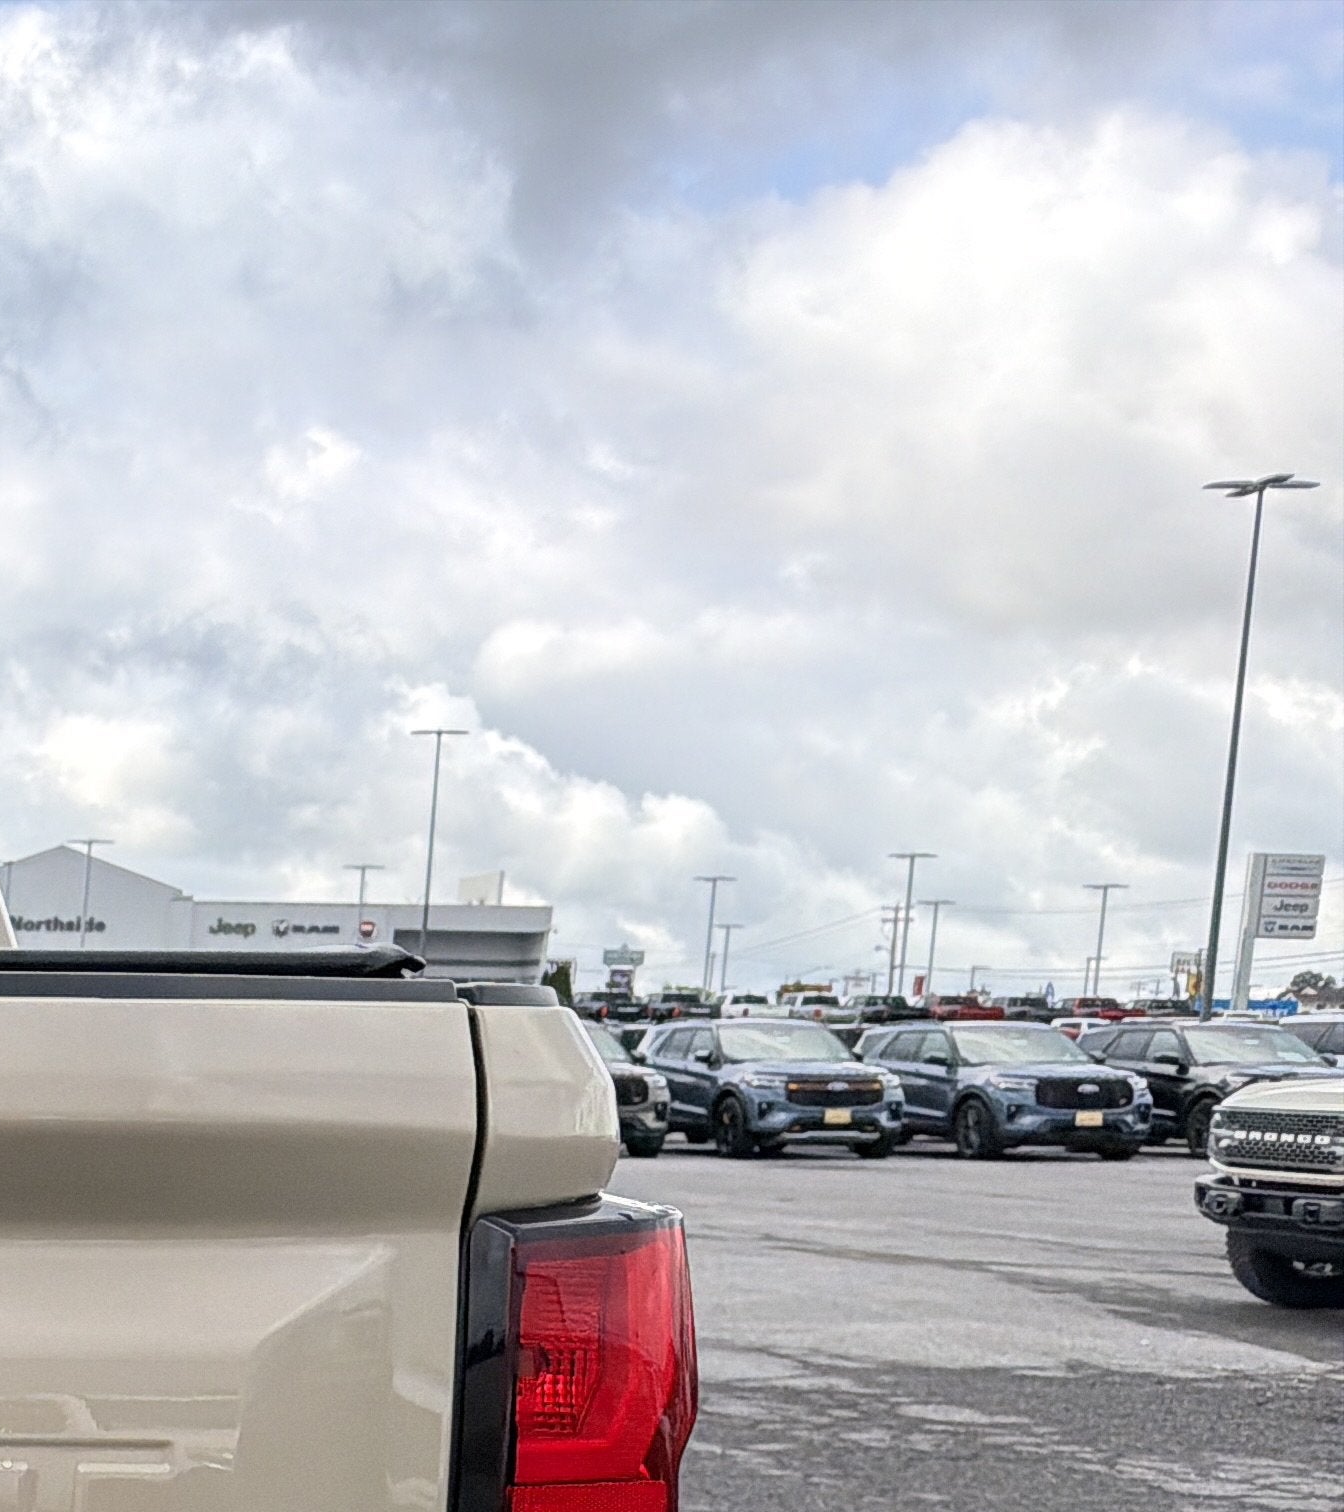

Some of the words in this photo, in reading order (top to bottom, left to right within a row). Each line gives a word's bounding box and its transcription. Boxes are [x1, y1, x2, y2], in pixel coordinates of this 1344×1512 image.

[1273, 899, 1309, 914] Jeep
[10, 915, 106, 932] Northside
[209, 917, 256, 938] Jeep
[1233, 1130, 1331, 1145] BRONCO
